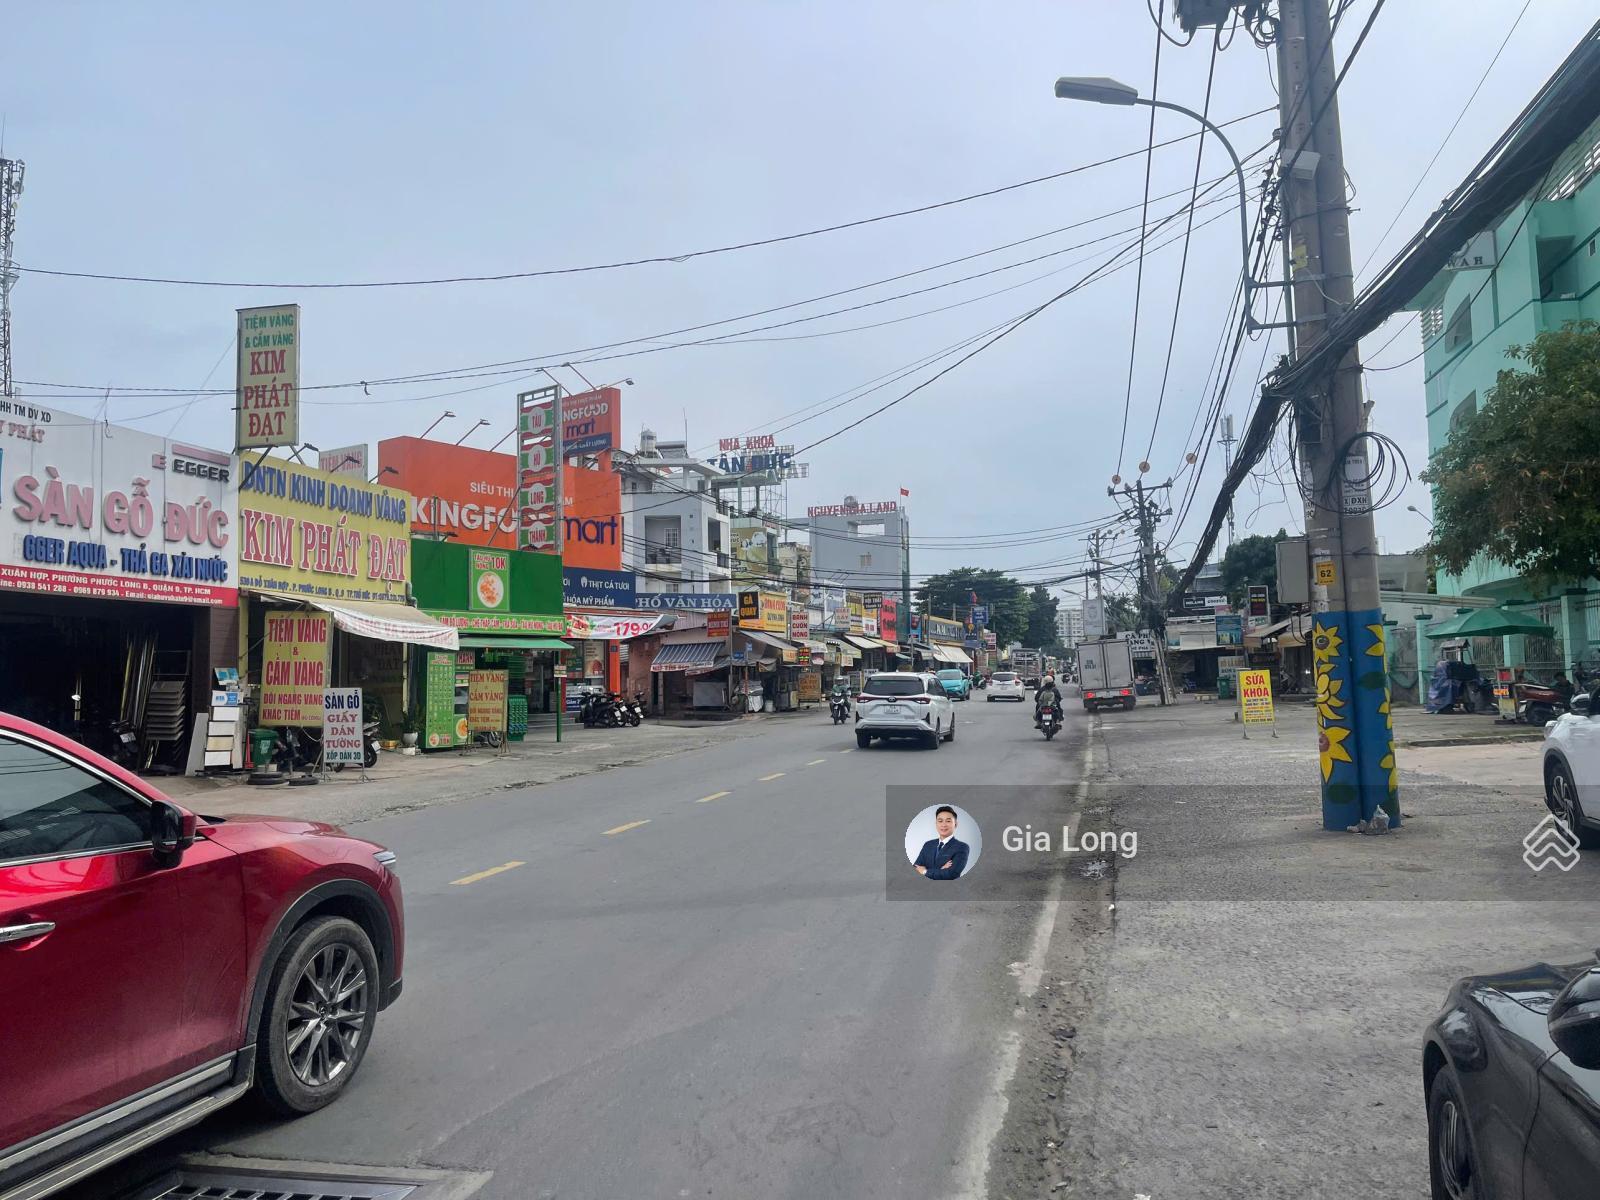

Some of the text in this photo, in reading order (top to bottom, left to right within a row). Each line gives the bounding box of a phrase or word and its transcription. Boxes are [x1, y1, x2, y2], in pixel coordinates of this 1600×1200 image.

[245, 311, 294, 332] TIỆM VÀNG
[245, 331, 294, 349] & CẦM VÀNG
[249, 349, 287, 376] KIM
[243, 376, 294, 410] PHÁT
[14, 404, 52, 423] TM DV XD
[247, 411, 287, 442] ĐẠT
[566, 416, 596, 439] mart
[719, 434, 775, 451] NHA KHOA
[173, 458, 230, 482] EGGER
[243, 460, 407, 525] DNTN KINH DOANH VÀNG
[470, 480, 495, 496] SIÊU
[13, 465, 229, 548] SÀN GỖ ĐỨC
[531, 491, 544, 505] LONG
[242, 509, 407, 593] KIM PHÁT ĐẠT
[66, 541, 108, 570] AQUA
[120, 543, 148, 575] THẢ
[150, 551, 169, 577] GA
[195, 554, 228, 581] NƯỚC
[492, 557, 506, 570] 10K
[1320, 569, 1332, 578] 62
[1, 568, 27, 579] XUÂN
[30, 571, 50, 582] HỢP.
[52, 573, 89, 584] PHƯỜNG
[90, 577, 119, 588] PHƯỚC
[120, 580, 141, 589] LONG
[184, 586, 194, 595] TP.
[195, 588, 211, 597] HCM
[589, 580, 604, 591] THỊT
[605, 580, 614, 590] CÁ
[614, 581, 630, 591] TƯƠI
[126, 590, 147, 600] Email:
[583, 595, 594, 604] MỸ
[595, 594, 615, 606] PHẨM
[636, 593, 734, 608] HỐ VĂN HÓA
[740, 607, 758, 618] QUAY
[268, 615, 295, 647] TIỆM
[297, 615, 327, 643] VÀNG
[292, 646, 299, 656] &
[265, 653, 324, 687] CẦM VÀNG
[1244, 672, 1266, 685] SỬA
[278, 692, 302, 705] NGANG
[325, 689, 360, 710] SÀN GỖ
[327, 710, 358, 723] GIẤY
[331, 725, 355, 736] DÁN
[326, 738, 361, 749] TƯỜNG
[339, 750, 352, 760] DÁN
[353, 751, 362, 761] 3D
